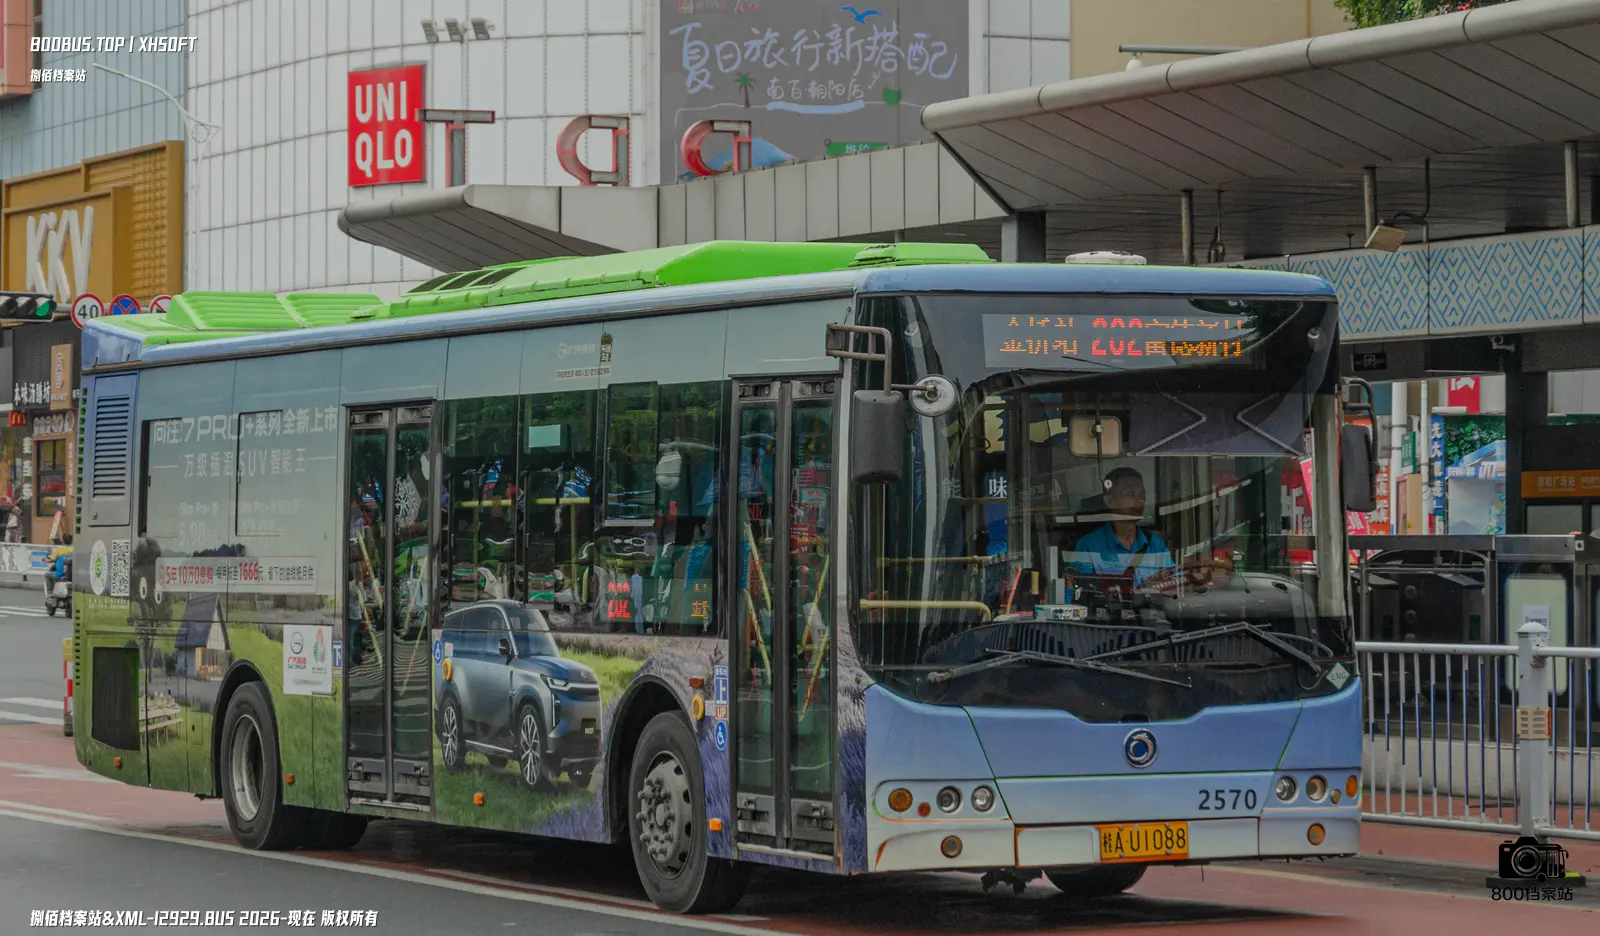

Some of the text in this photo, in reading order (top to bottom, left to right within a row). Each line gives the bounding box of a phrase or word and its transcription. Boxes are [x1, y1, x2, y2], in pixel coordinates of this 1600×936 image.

[669, 20, 957, 94] 夏日旅行新搭配
[354, 80, 408, 124] UNI
[354, 129, 413, 179] QLO
[26, 205, 95, 305] KKV
[77, 303, 99, 319] 40
[1198, 789, 1257, 811] 2570
